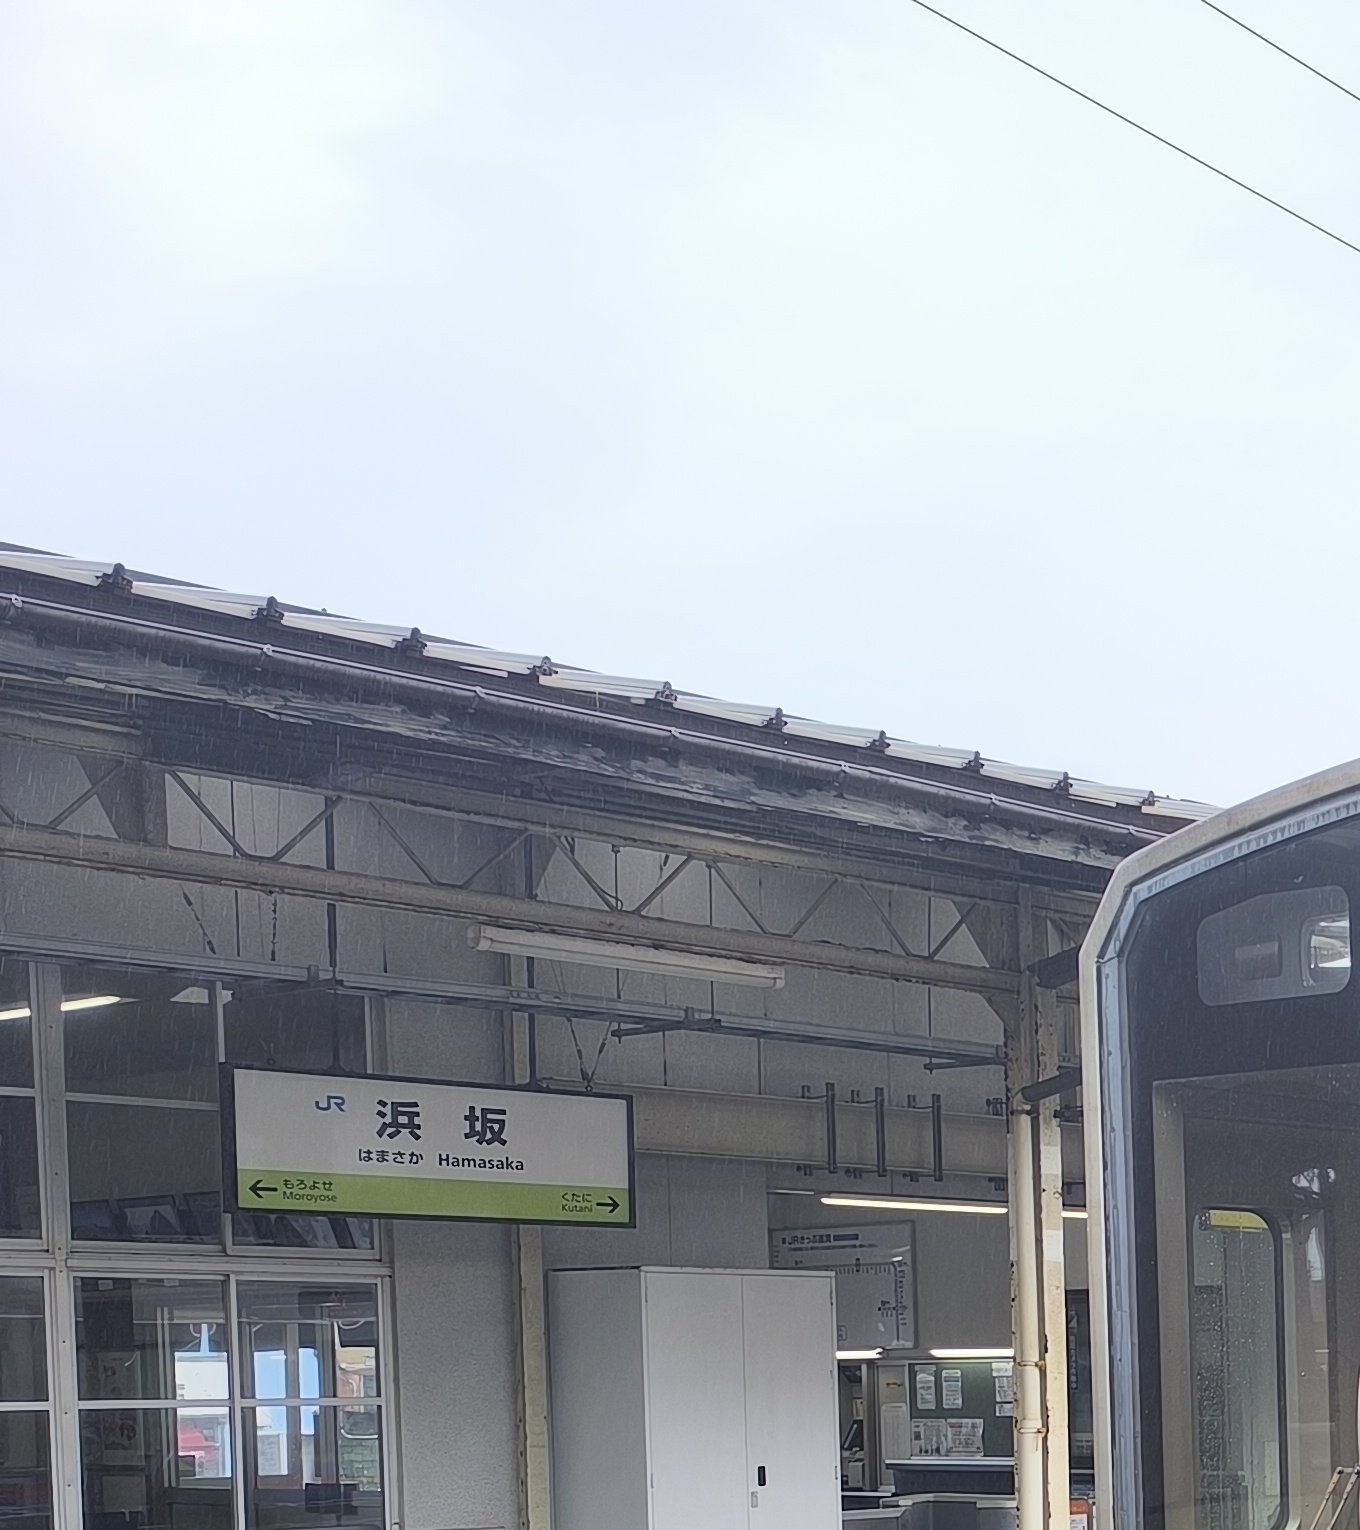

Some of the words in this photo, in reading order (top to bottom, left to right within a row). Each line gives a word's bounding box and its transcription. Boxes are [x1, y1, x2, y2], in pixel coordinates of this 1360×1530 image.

[315, 1095, 346, 1112] JR
[375, 1099, 508, 1147] 浜坂
[358, 1148, 424, 1166] はまさか
[438, 1153, 525, 1172] Hamasaka
[282, 1178, 334, 1192] もろよせ
[282, 1190, 338, 1203] Moroyose
[561, 1191, 593, 1204] くたに
[561, 1203, 593, 1214] Kutani
